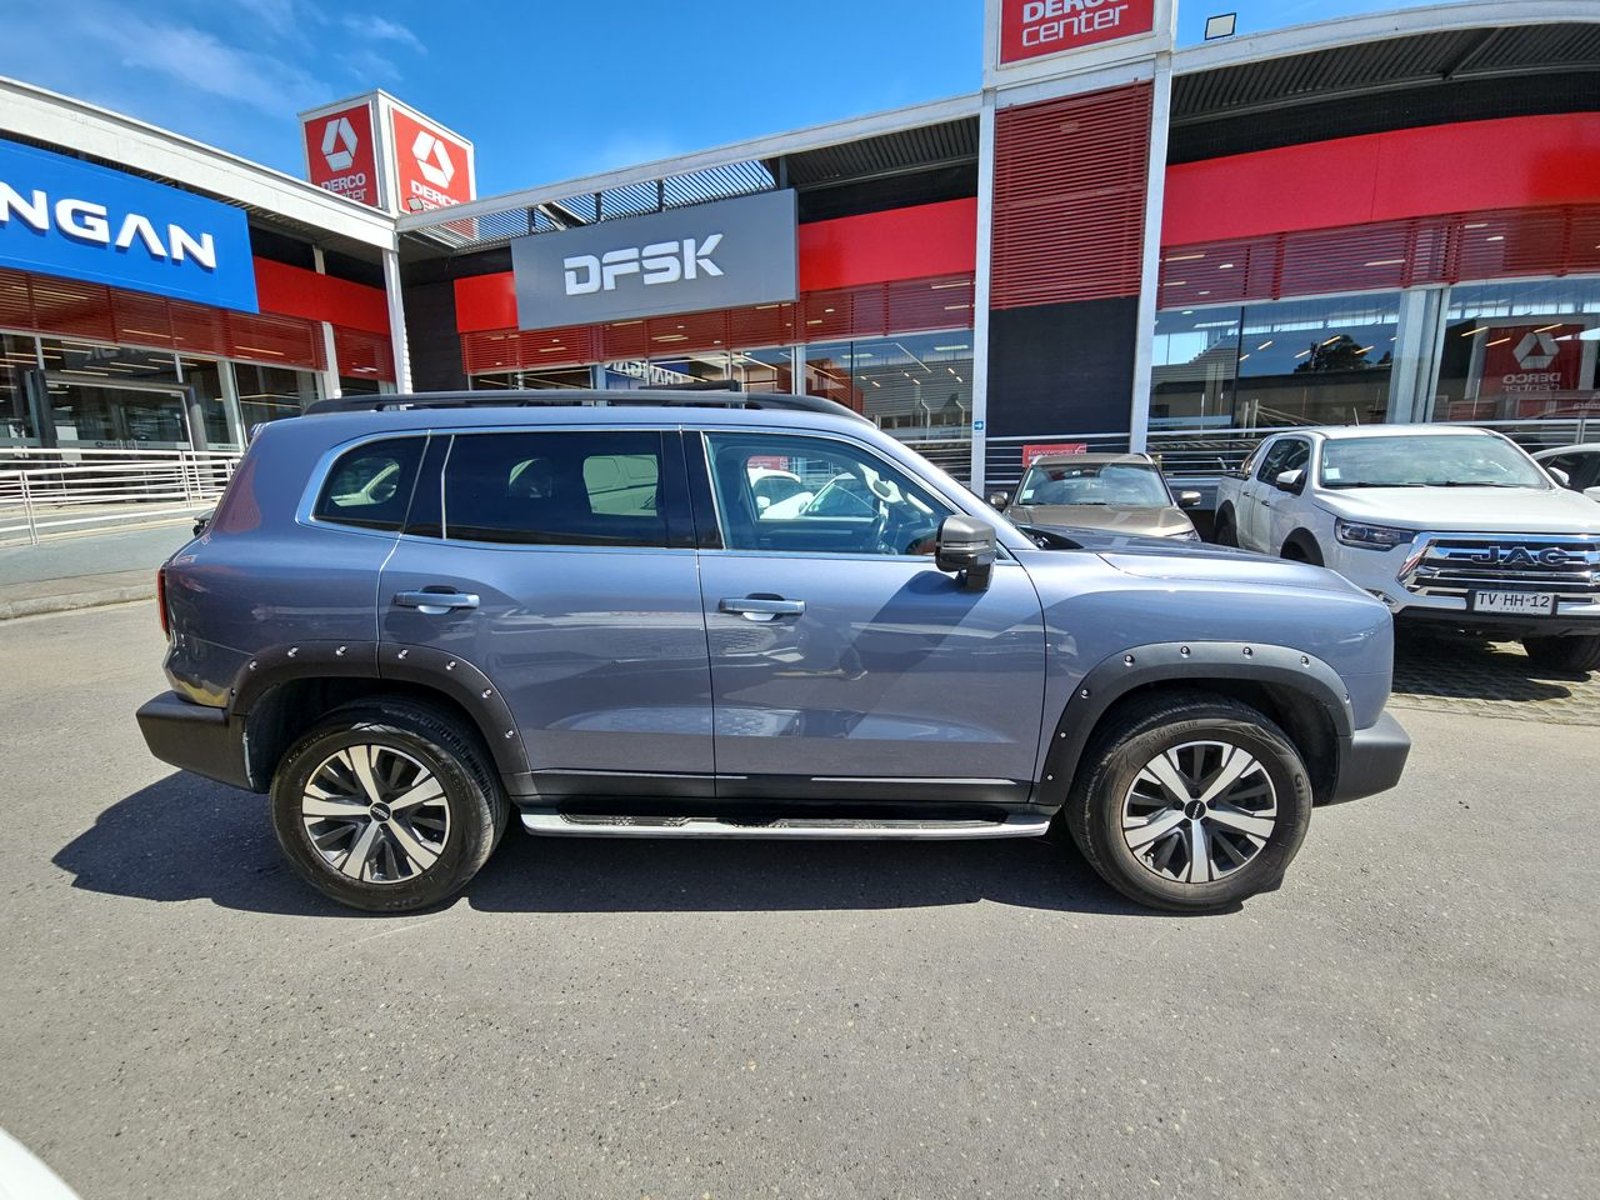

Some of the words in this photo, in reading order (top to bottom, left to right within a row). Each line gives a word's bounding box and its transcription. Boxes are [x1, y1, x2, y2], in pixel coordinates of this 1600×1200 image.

[1022, 0, 1121, 24] DER
[1022, 4, 1129, 47] center
[321, 172, 367, 192] DERCO
[0, 182, 216, 269] NGAN
[563, 233, 724, 296] DFSK
[1470, 545, 1571, 567] JAC
